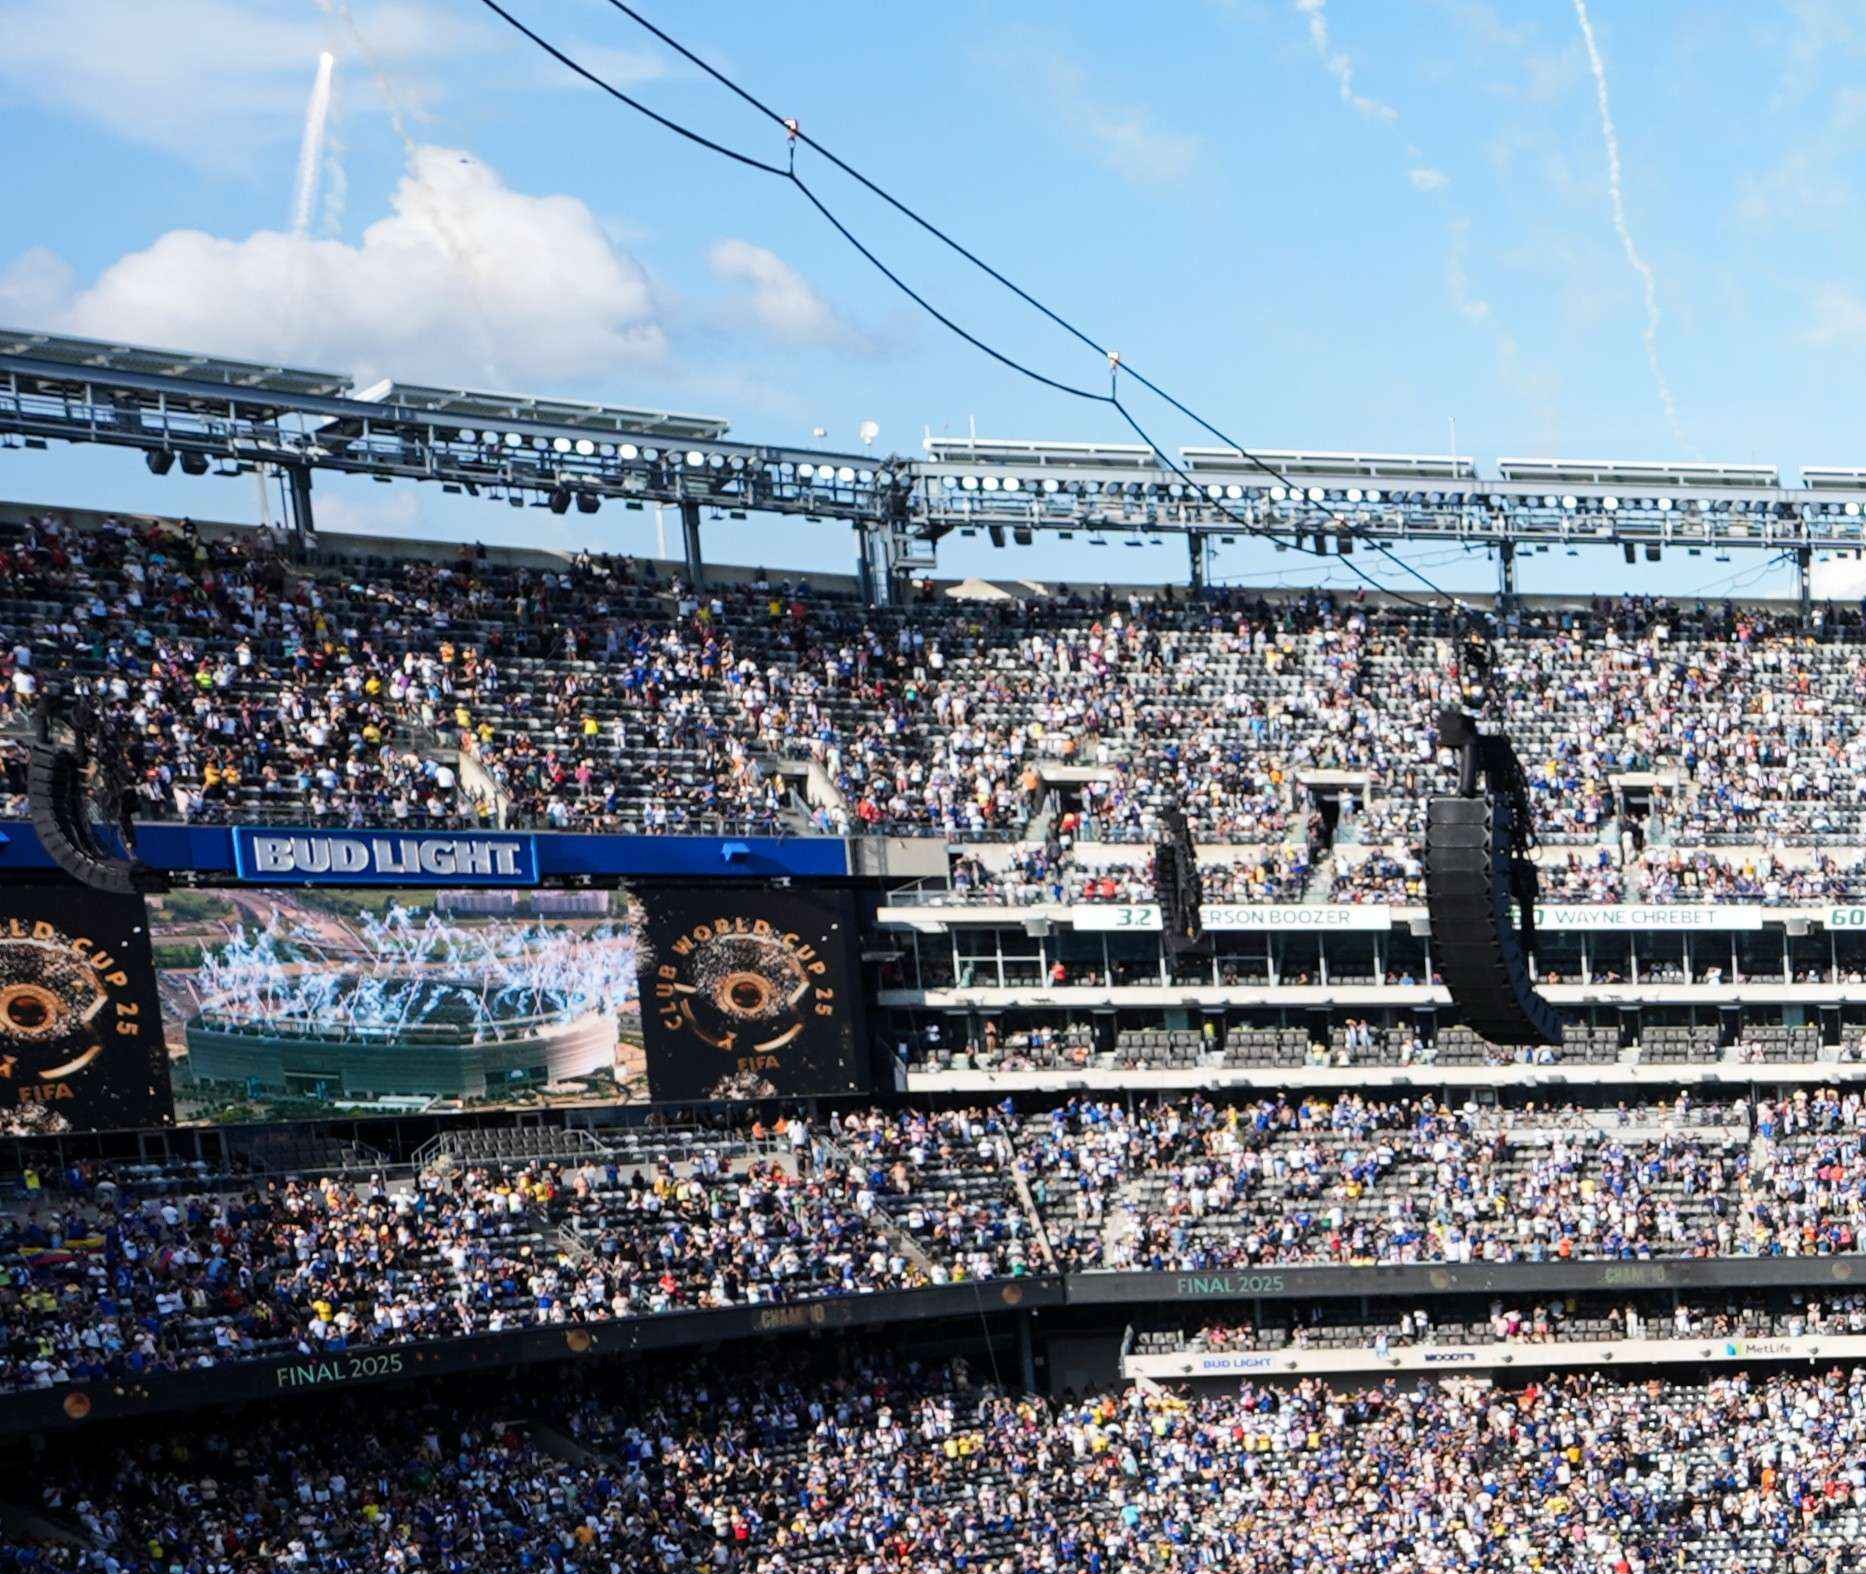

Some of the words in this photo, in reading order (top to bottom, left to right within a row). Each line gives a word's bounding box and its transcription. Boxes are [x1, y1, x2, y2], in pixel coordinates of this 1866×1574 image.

[253, 836, 369, 872] BUD
[372, 838, 521, 875] LIGHT
[1200, 910, 1265, 925] ERSON
[1270, 910, 1350, 925] BOOZER
[1554, 910, 1626, 925] WAYNE
[1631, 910, 1717, 925] CHREBET
[1830, 908, 1865, 927] 60
[656, 964, 682, 1030] CLUB
[671, 916, 770, 954] WORLD
[782, 932, 826, 975] CUP
[814, 987, 834, 1016] 25
[71, 937, 128, 987] CUP
[116, 1002, 140, 1036] 25
[737, 1055, 781, 1072] FIFA
[18, 1083, 75, 1102] FIFA
[1178, 1277, 1235, 1293] FINAL
[1239, 1275, 1285, 1292] 2025
[1745, 1343, 1792, 1355] MetLife
[276, 1360, 346, 1388] FINAL
[349, 1353, 403, 1378] 2025
[1203, 1358, 1230, 1369] BUD
[1233, 1357, 1271, 1369] LIGHT
